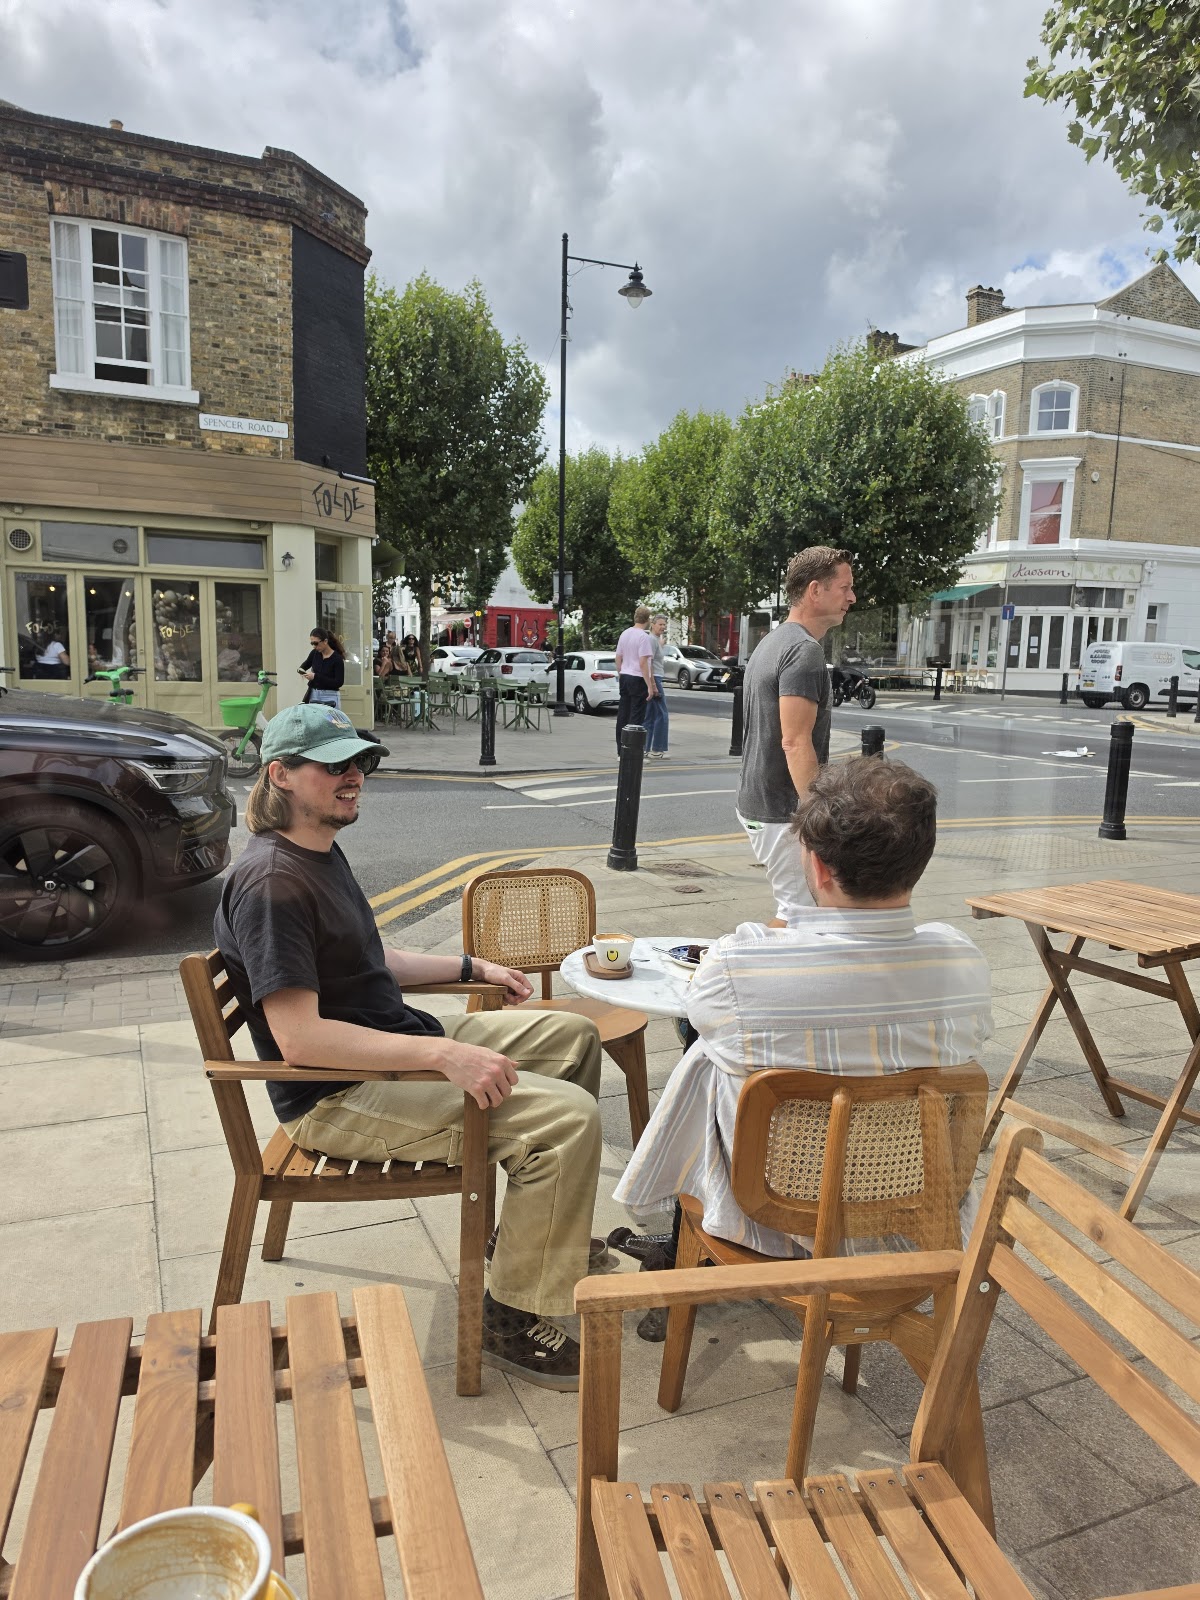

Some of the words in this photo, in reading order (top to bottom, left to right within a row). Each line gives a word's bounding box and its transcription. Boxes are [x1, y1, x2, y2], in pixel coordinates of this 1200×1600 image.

[203, 417, 244, 431] SPENCER
[248, 422, 274, 434] ROAD
[312, 482, 365, 522] FOLDE
[160, 624, 194, 638] FOLDE
